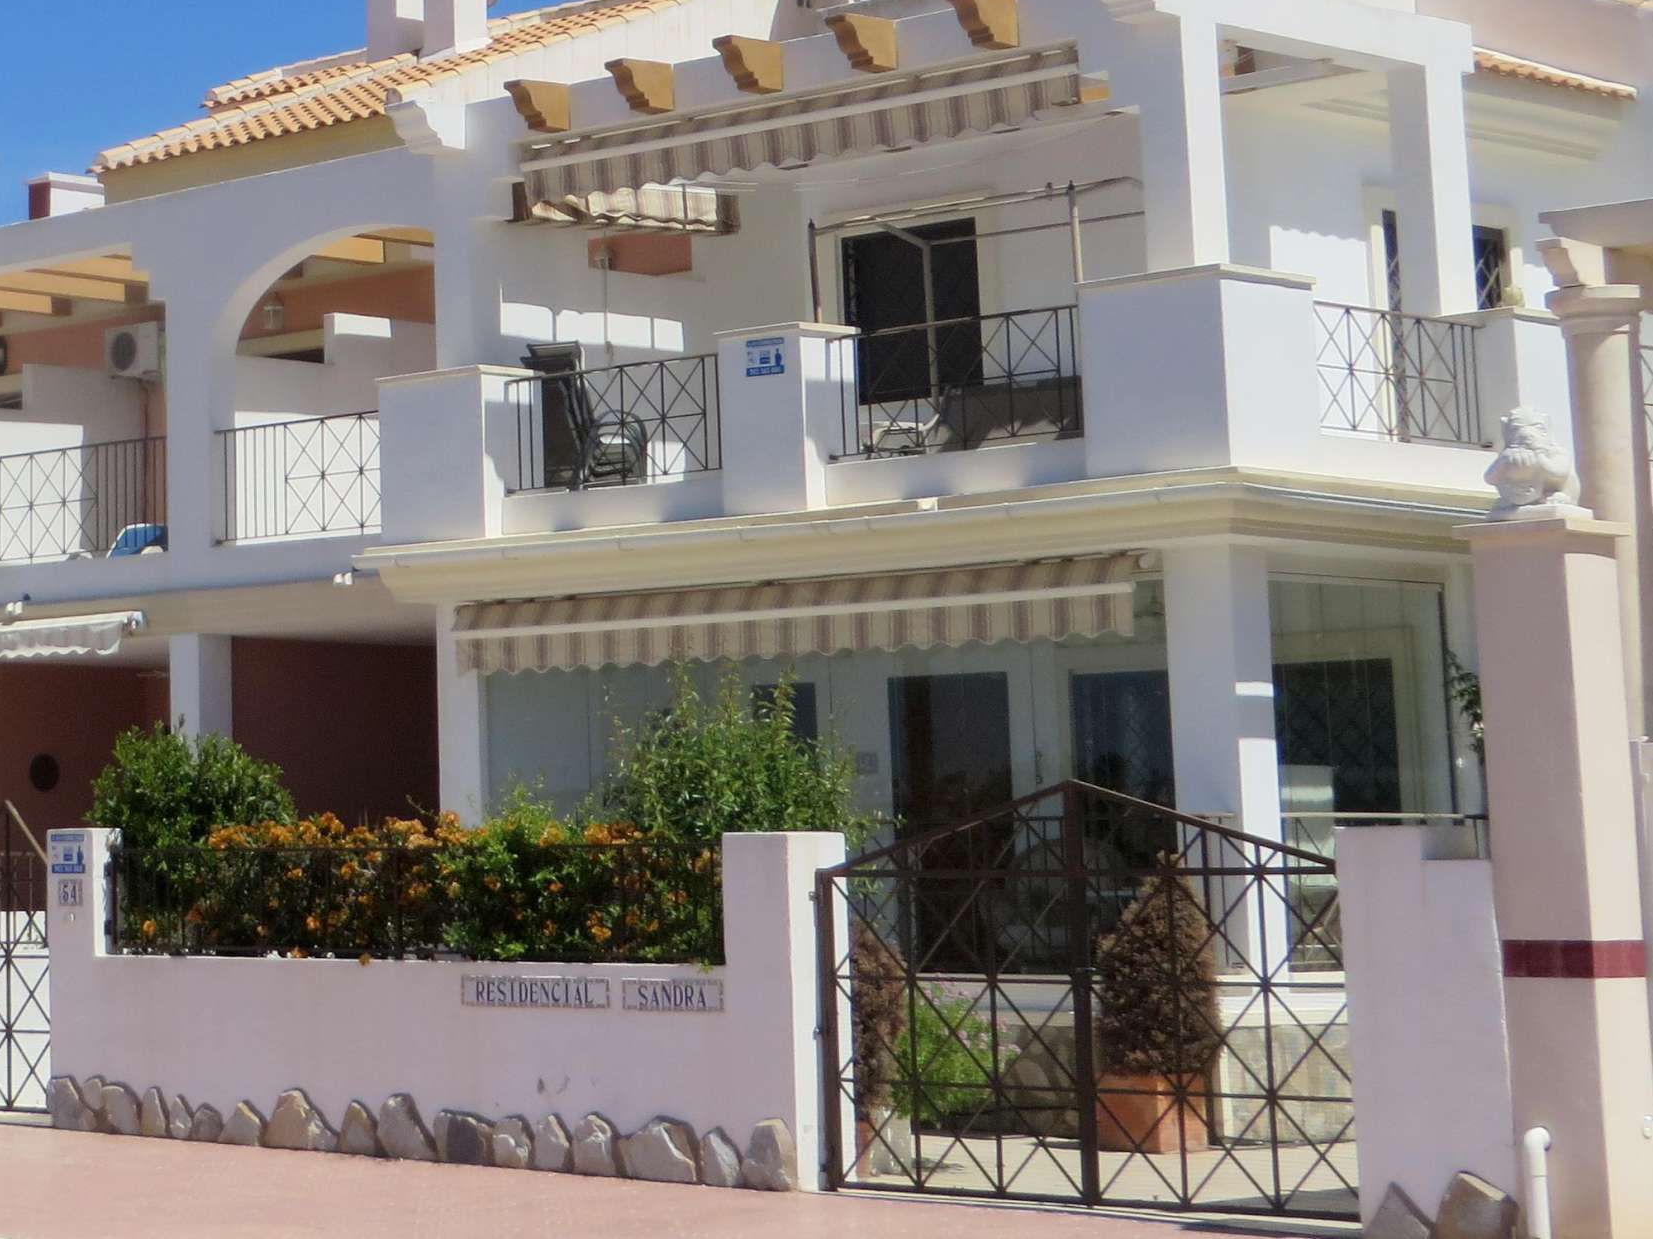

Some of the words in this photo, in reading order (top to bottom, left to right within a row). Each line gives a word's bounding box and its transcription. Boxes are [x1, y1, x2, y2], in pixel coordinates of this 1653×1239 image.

[61, 884, 77, 903] 54
[475, 980, 594, 1004] RESIDENCIAL
[637, 984, 707, 1008] SANDRA
